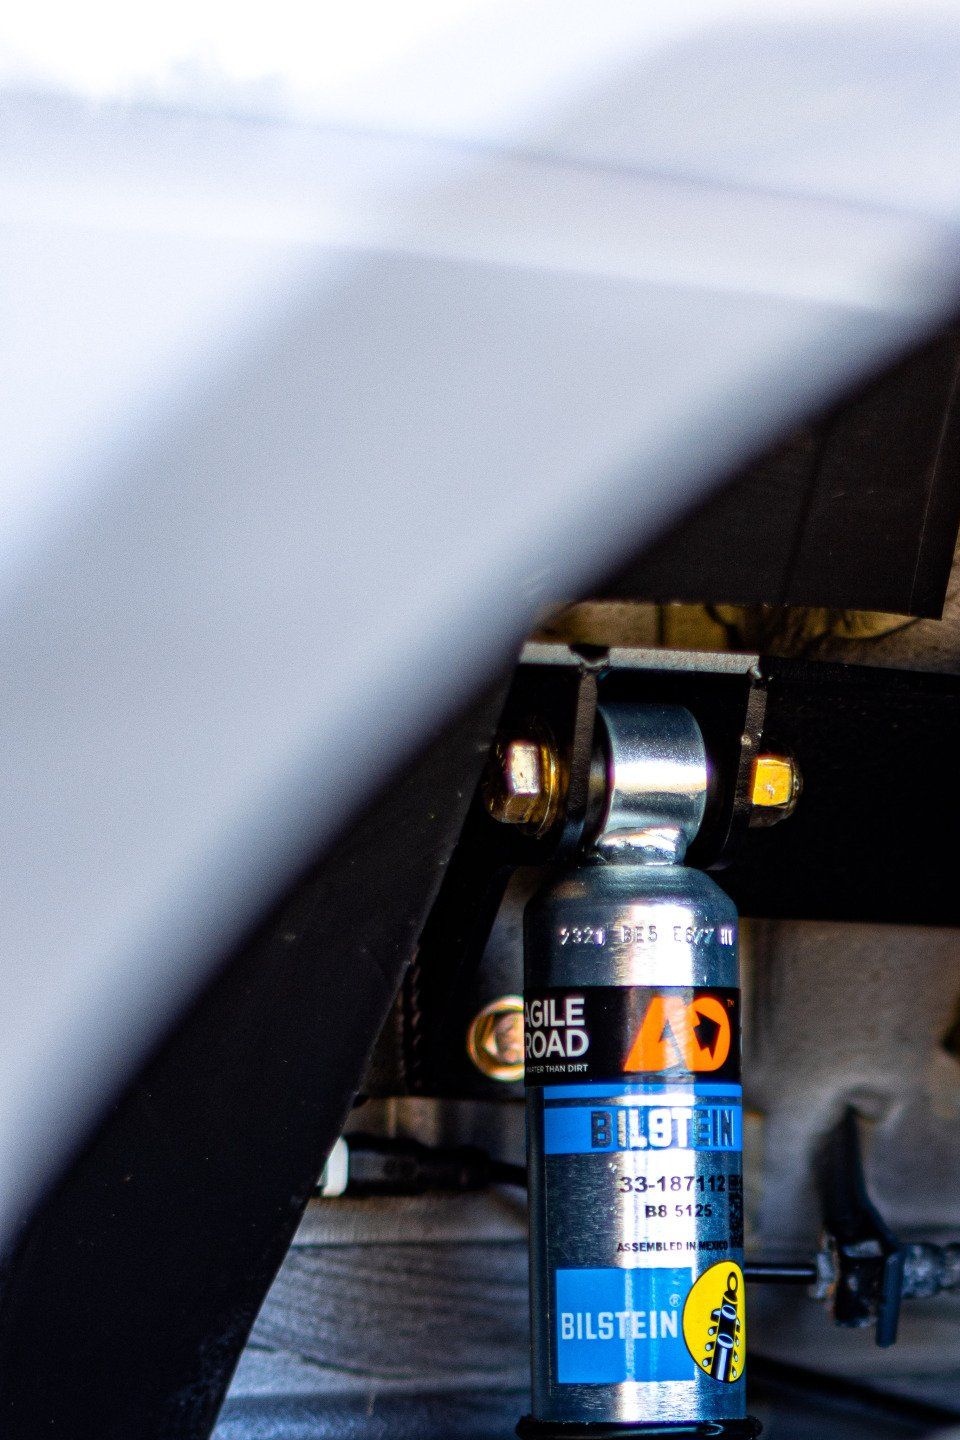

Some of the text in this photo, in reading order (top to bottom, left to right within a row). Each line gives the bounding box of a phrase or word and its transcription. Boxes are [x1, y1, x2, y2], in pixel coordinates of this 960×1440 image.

[545, 1064, 566, 1073] THAN
[567, 1063, 589, 1073] DIRT
[591, 1108, 734, 1149] BILSTEIN
[619, 1175, 726, 1193] 33-187112
[645, 1203, 713, 1218] B8 5125
[617, 1240, 728, 1252] ASSEMBLED IN MEXICO
[561, 1310, 678, 1340] BILSTEIN
